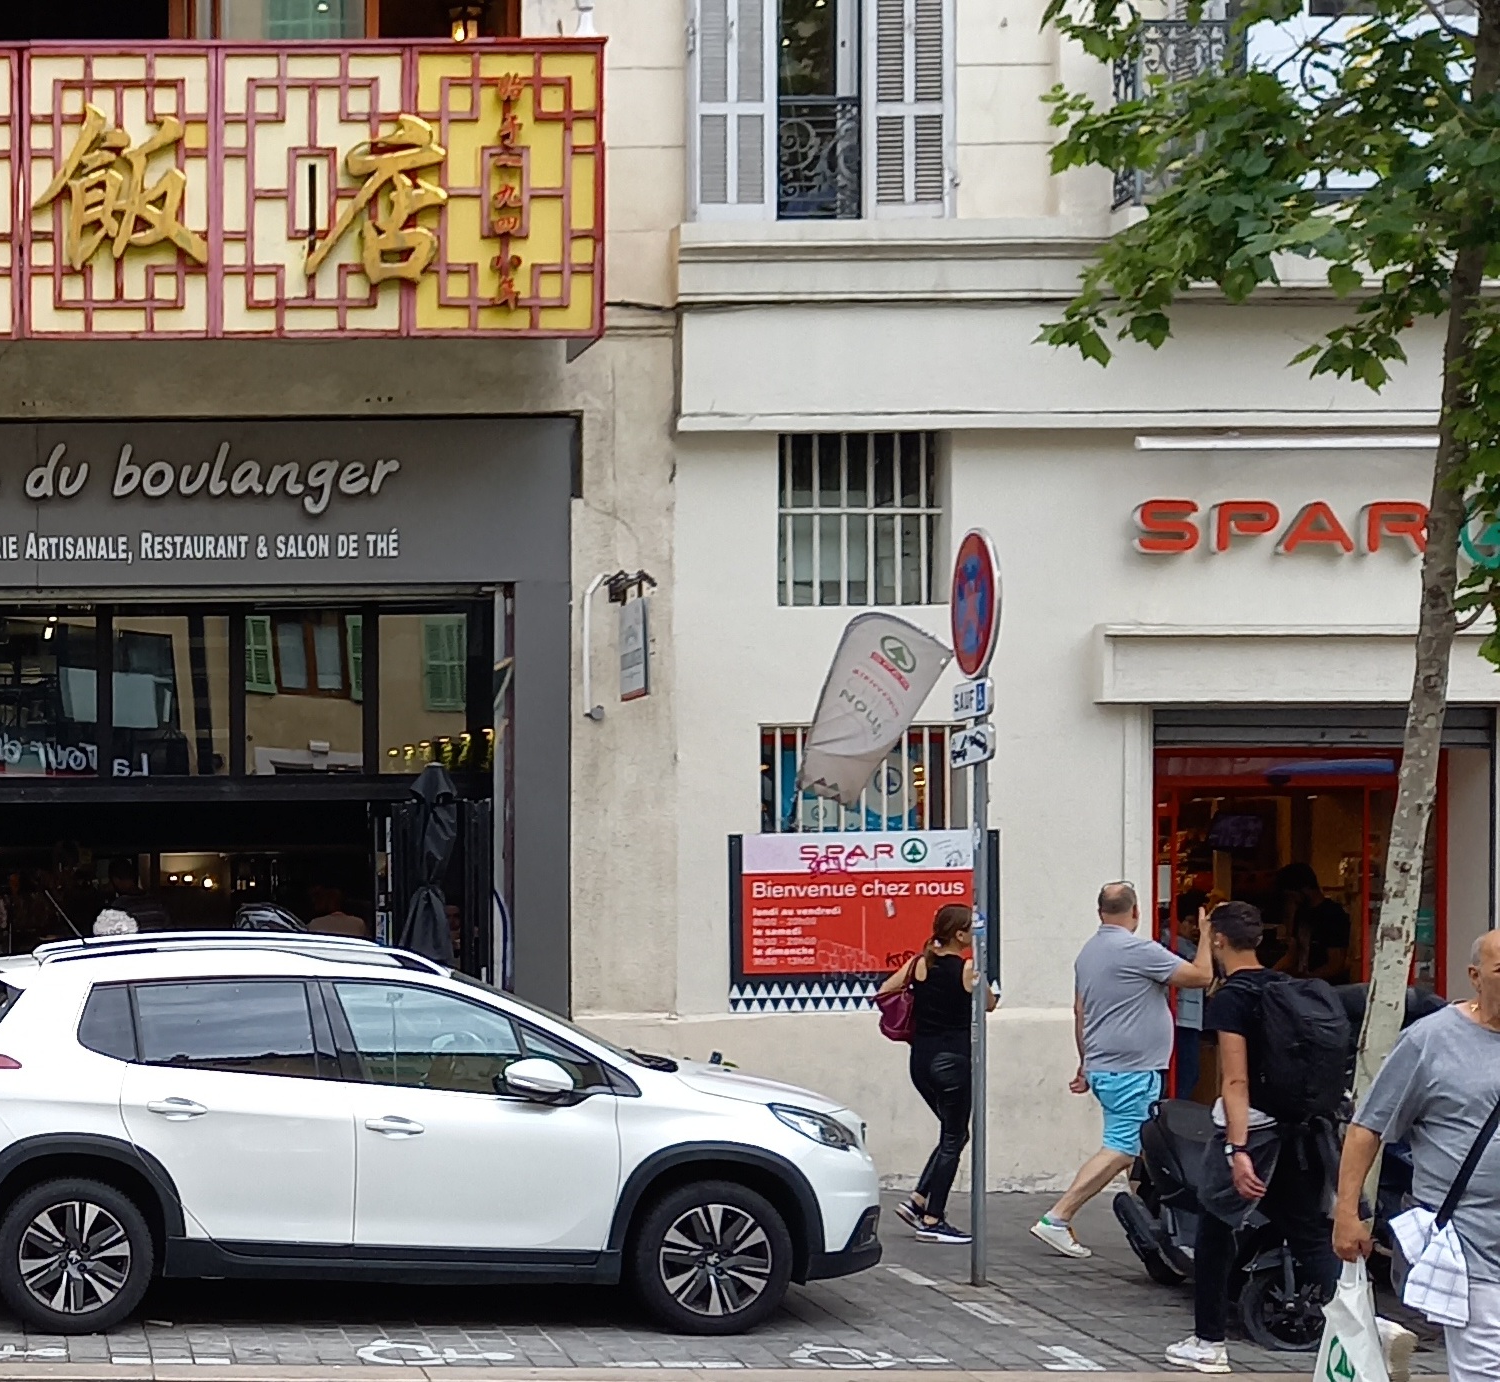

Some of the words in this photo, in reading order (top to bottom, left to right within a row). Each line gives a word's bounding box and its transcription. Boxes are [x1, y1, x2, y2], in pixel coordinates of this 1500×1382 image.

[25, 442, 89, 498] du
[113, 442, 399, 514] boulanger
[1134, 499, 1428, 553] SPAR
[25, 532, 133, 564] ARTISANALE,
[141, 532, 248, 559] RESTAURANT
[256, 538, 268, 558] &
[276, 534, 329, 558] SALON
[337, 534, 358, 557] DE
[366, 529, 399, 557] THÉ
[799, 843, 893, 861] SPAR
[752, 881, 857, 898] Bienvenue
[861, 879, 910, 897] chez
[915, 881, 965, 896] nous
[752, 907, 779, 916] lundi
[781, 908, 794, 916] au
[796, 906, 841, 916] vendredi
[752, 928, 763, 936] le
[764, 926, 802, 936] samedi
[752, 947, 763, 956] le
[764, 946, 815, 956] dimanche
